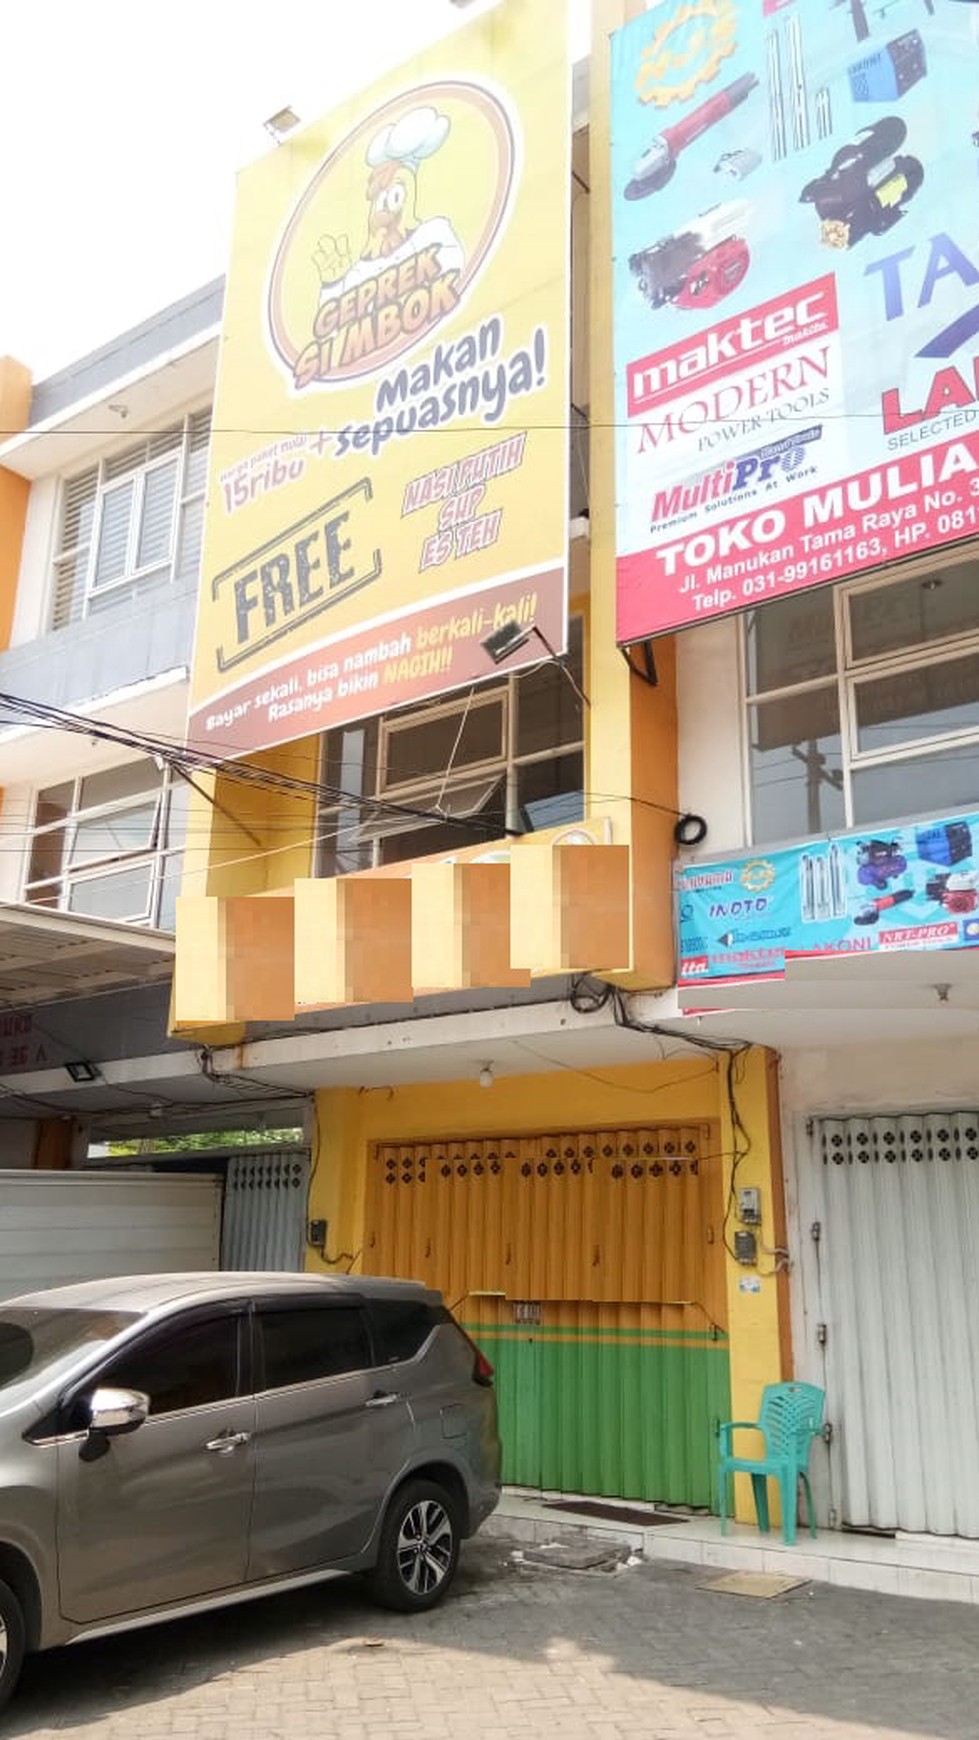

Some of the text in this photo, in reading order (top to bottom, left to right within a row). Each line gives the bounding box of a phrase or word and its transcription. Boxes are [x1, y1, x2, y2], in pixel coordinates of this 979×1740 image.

[314, 243, 443, 339] GEPREK
[335, 328, 546, 456] sepuasnya!
[633, 292, 829, 399] maktec
[637, 345, 831, 455] MODERN
[697, 412, 762, 453] POWER
[767, 387, 831, 423] TOOLS
[880, 356, 979, 436] LA
[887, 408, 979, 453] SELECTED
[225, 460, 305, 513] 15ribu
[403, 434, 526, 515] NASI PUTIH
[650, 511, 698, 535] Premium
[704, 488, 758, 514] Solutions
[786, 465, 820, 487] Work
[655, 443, 979, 577] TOKO MULIA
[233, 510, 355, 645] FREE
[420, 510, 502, 571] ES TEH
[693, 506, 979, 613] Telp. 031-99161163, HP. 081
[706, 545, 795, 586] Manukan
[800, 525, 857, 553] Tama
[862, 498, 918, 531] Raya
[923, 488, 964, 516] No.
[206, 702, 251, 733] Bayar
[306, 658, 340, 687] bisa
[343, 635, 413, 673] nambah
[268, 647, 454, 724] Rasanya bikin NAGIH!!
